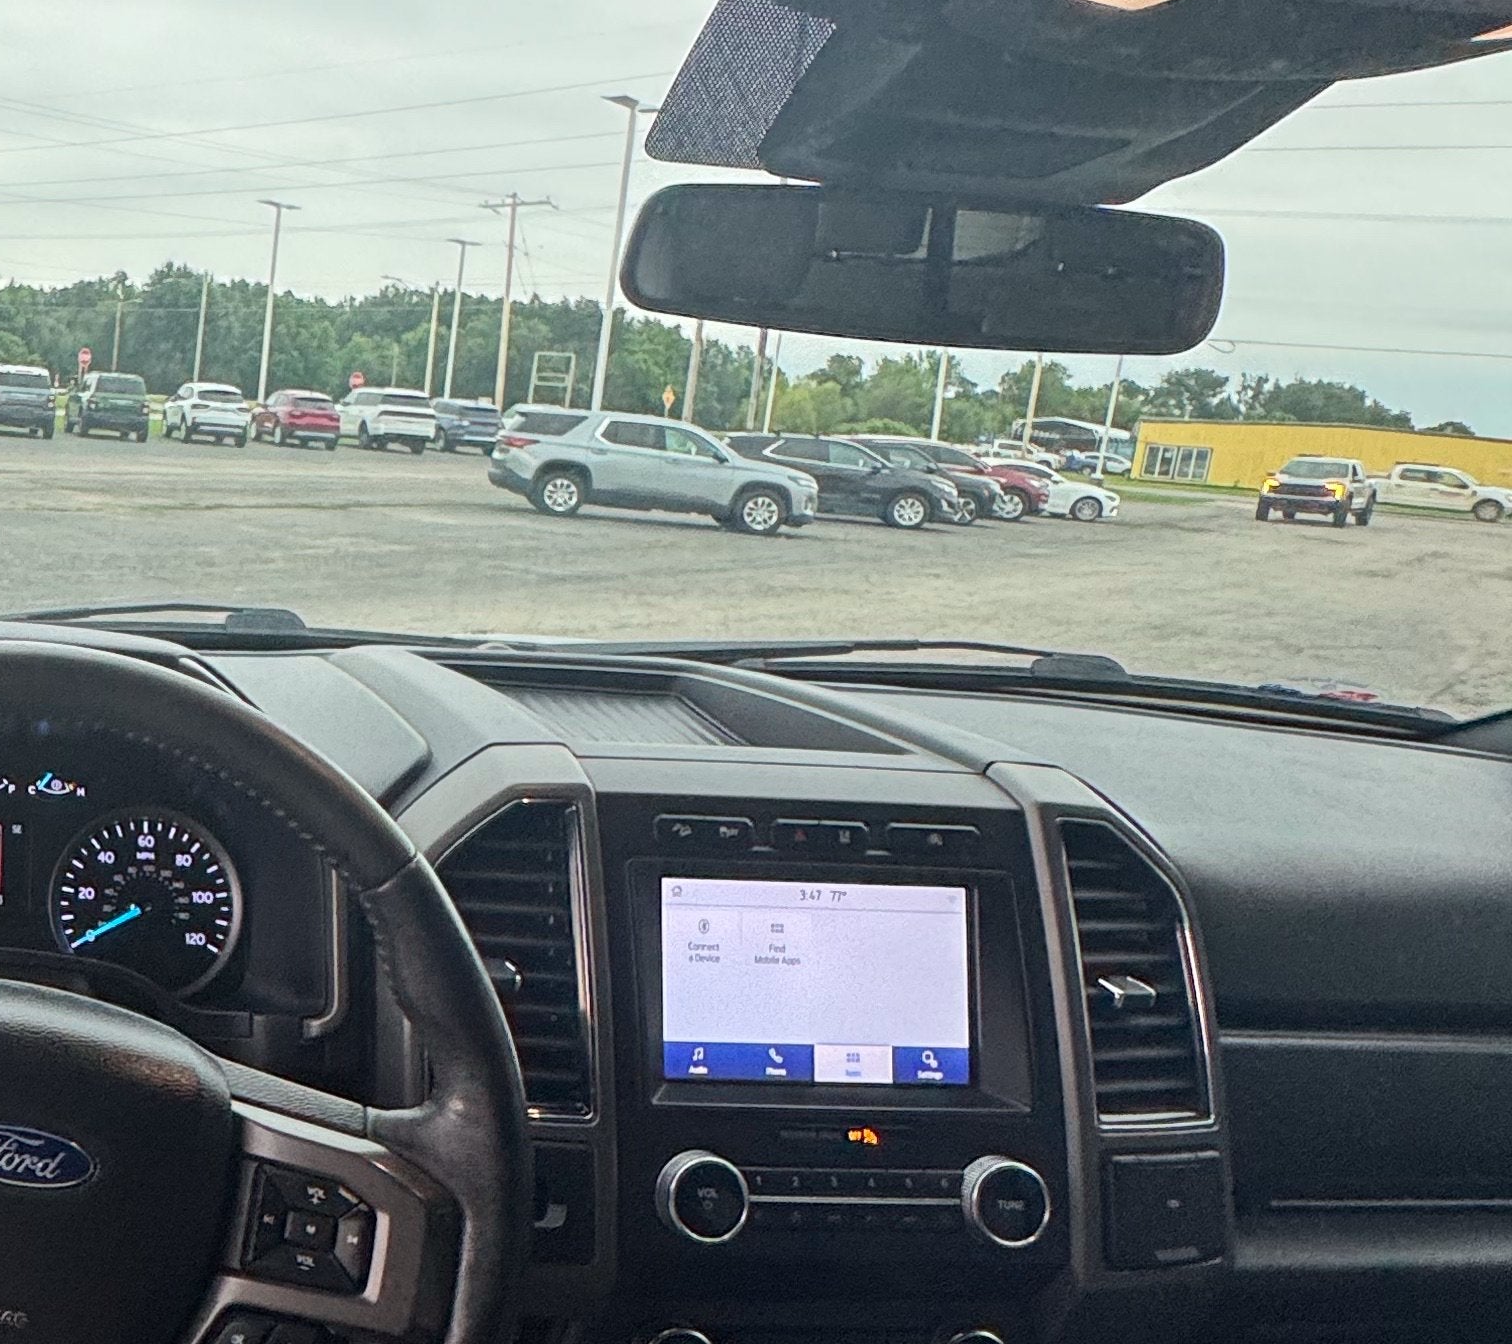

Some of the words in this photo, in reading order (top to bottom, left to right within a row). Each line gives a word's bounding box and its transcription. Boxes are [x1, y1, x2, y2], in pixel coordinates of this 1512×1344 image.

[137, 835, 155, 848] 60
[97, 851, 115, 864] 40
[175, 854, 192, 867] 80
[78, 887, 95, 900] 20
[191, 891, 214, 904] 100
[799, 889, 822, 901] 3:47
[185, 932, 206, 945] 120
[688, 941, 720, 952] Connect
[768, 943, 786, 954] Find
[695, 953, 720, 964] Device
[754, 954, 779, 965] Mobile
[781, 955, 801, 966] Apps
